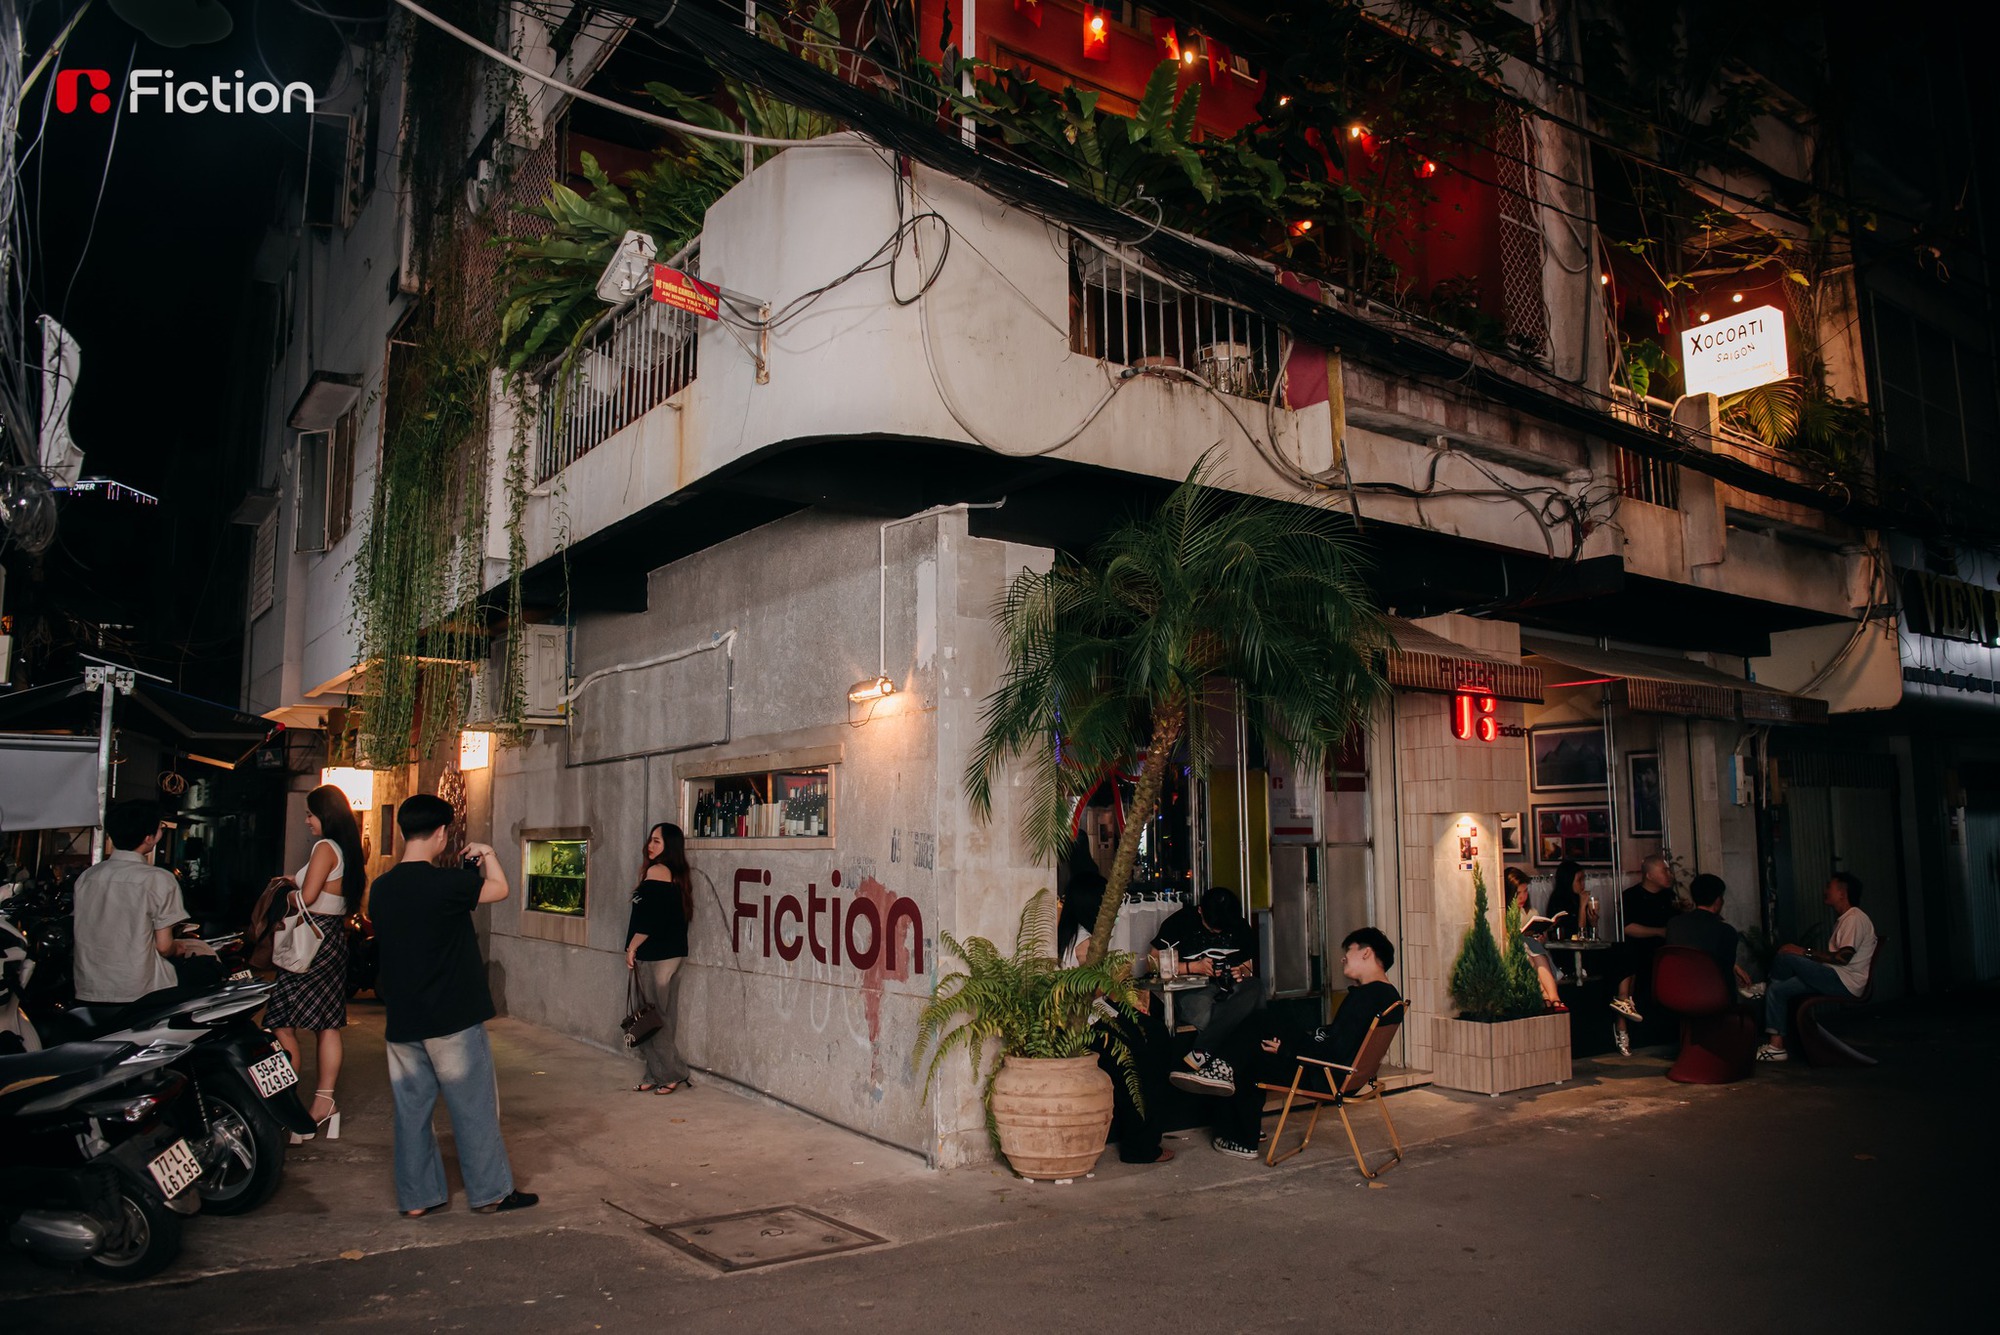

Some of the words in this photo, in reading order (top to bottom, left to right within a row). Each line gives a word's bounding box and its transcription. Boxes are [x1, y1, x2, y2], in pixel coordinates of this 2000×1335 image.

[671, 293, 686, 303] NINH
[678, 287, 696, 300] CAMERA
[1690, 319, 1765, 357] XOCOATI
[1716, 342, 1756, 363] SAIGON
[69, 482, 96, 491] OWER
[732, 867, 925, 975] Fiction
[261, 1068, 295, 1096] 249.69
[154, 1144, 187, 1176] 77-L1
[162, 1158, 200, 1196] 461.95
